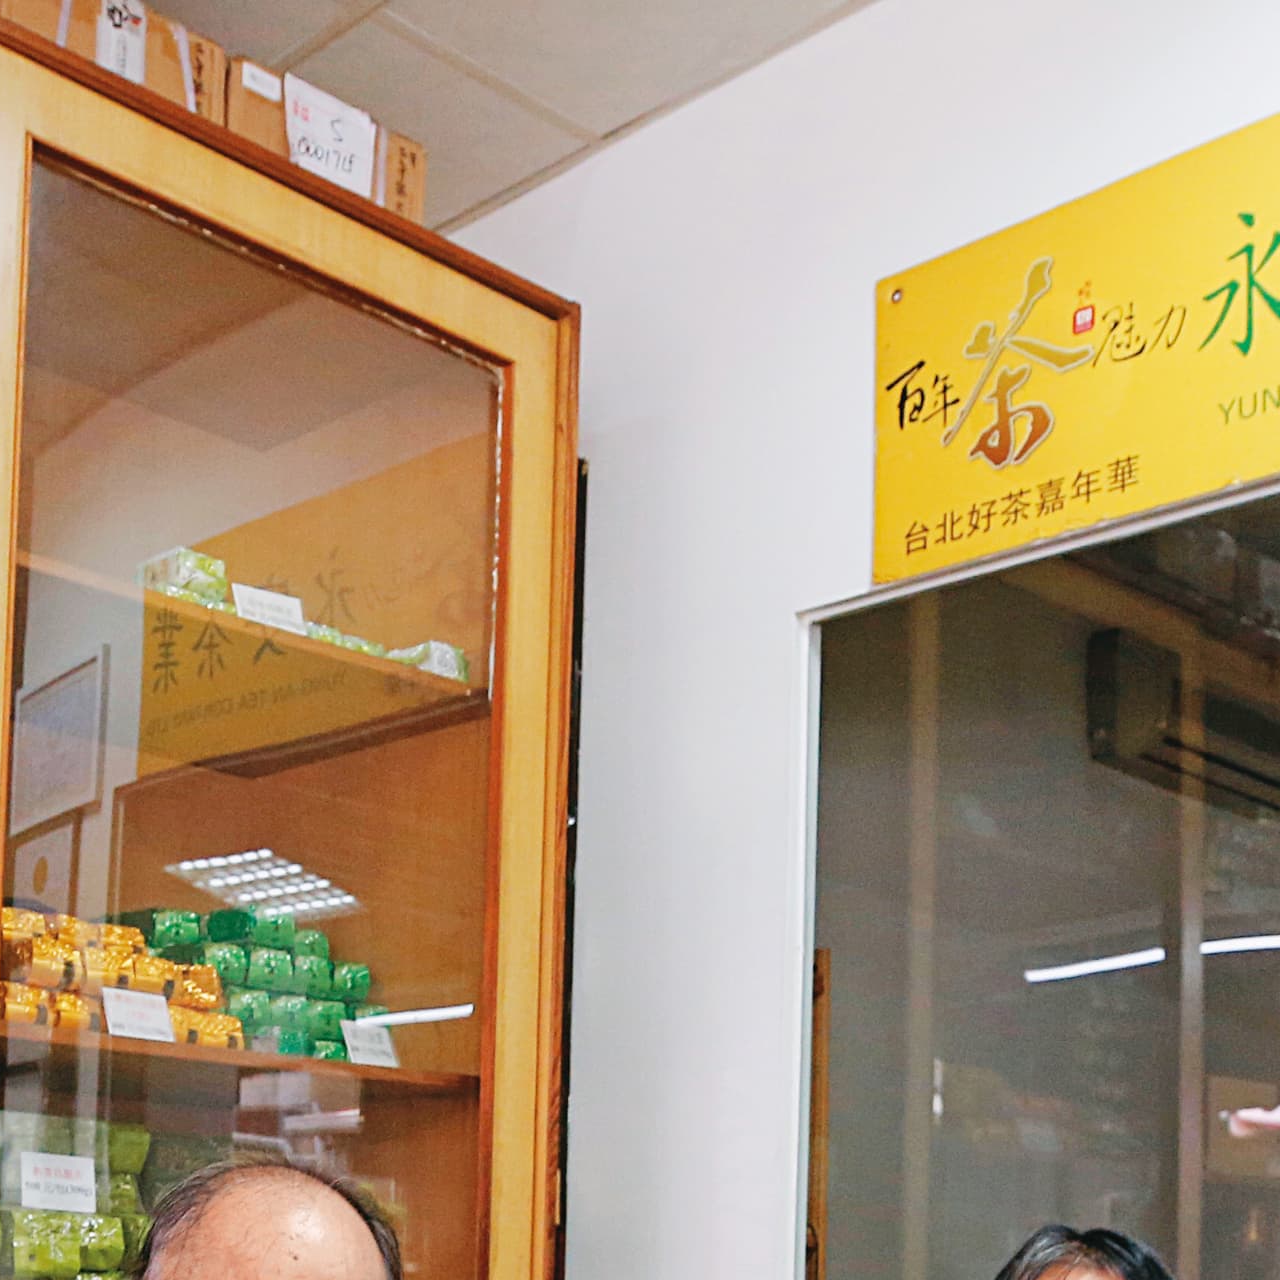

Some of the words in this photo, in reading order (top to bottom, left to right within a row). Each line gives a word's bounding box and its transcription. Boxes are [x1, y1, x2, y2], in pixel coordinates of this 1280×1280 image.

[904, 455, 1140, 557] 台北好茶嘉年華
